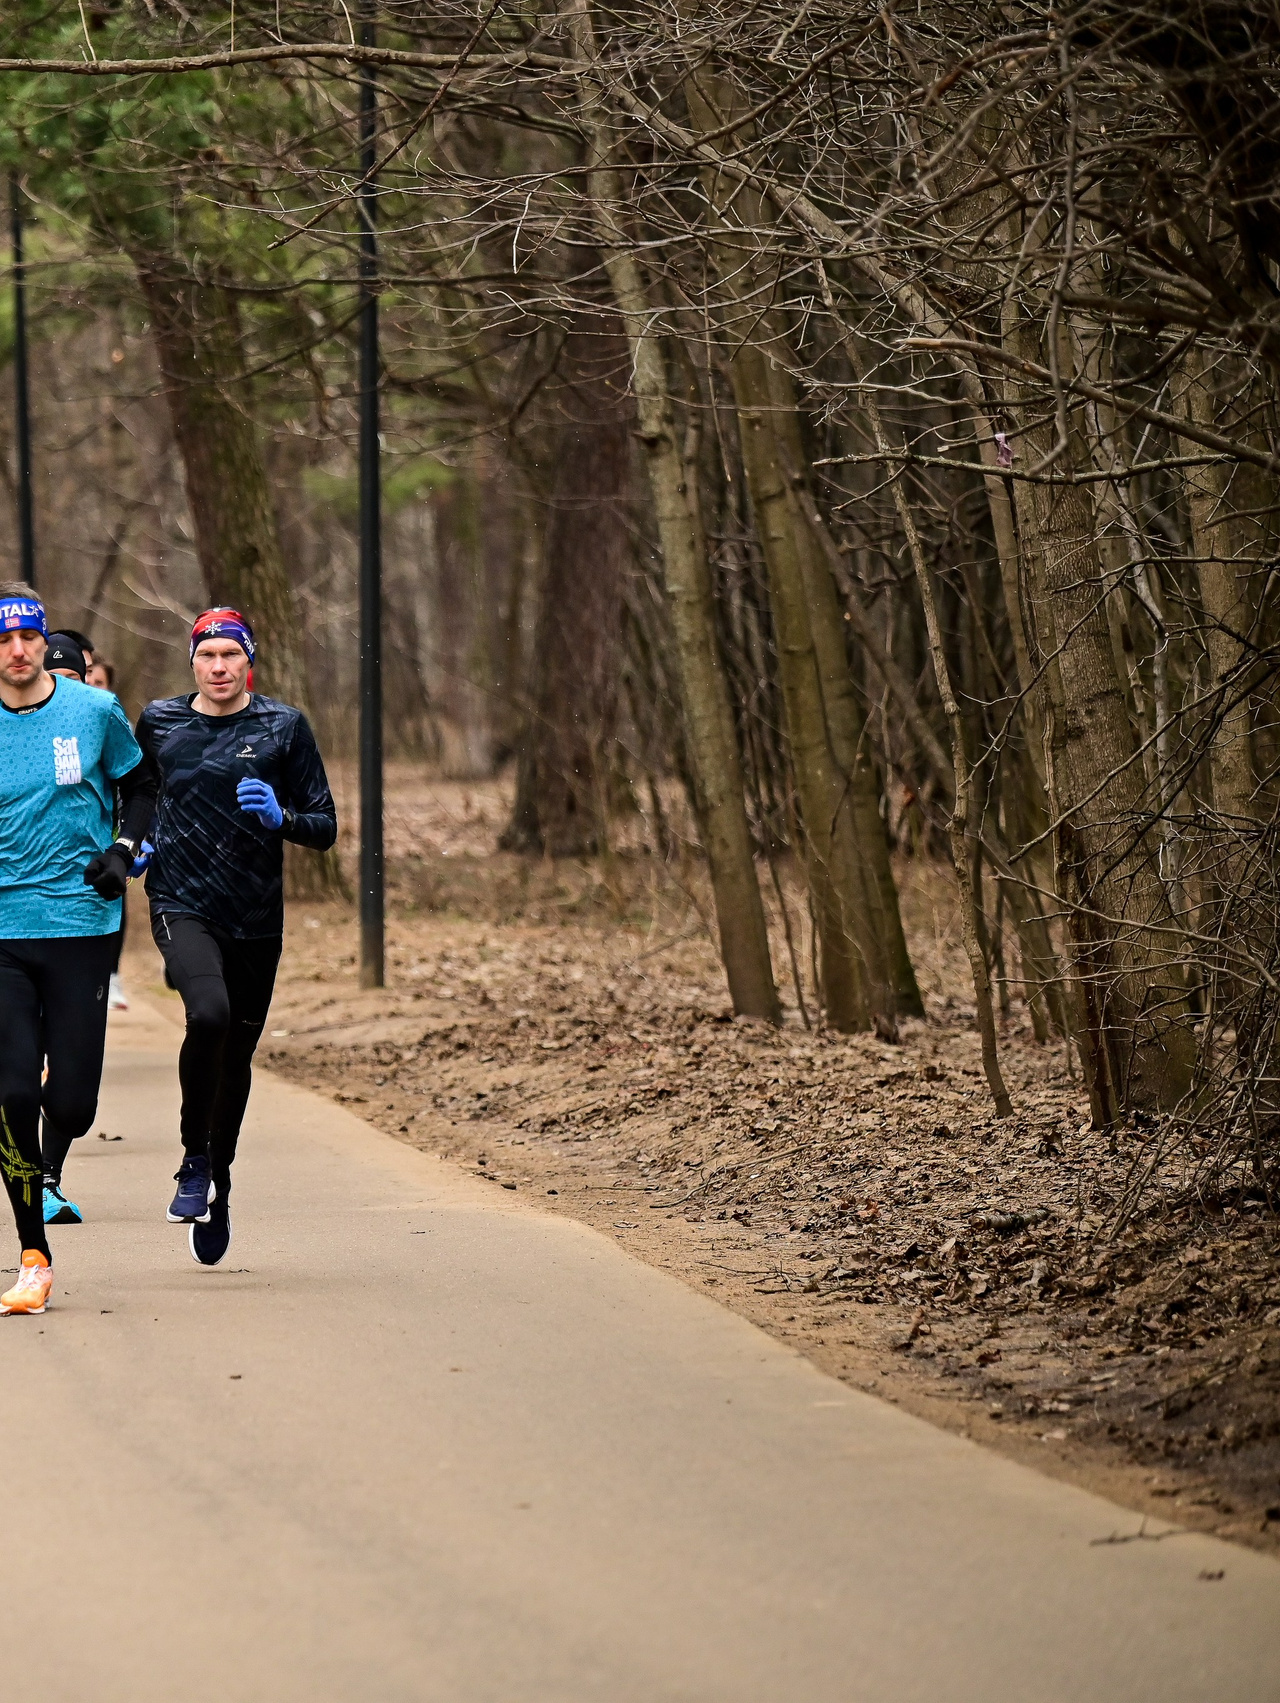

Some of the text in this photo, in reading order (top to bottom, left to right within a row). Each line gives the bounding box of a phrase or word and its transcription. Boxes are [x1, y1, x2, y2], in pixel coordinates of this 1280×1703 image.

[53, 737, 79, 757] Sat
[54, 755, 81, 771] 9AM
[55, 769, 81, 786] 5KM
